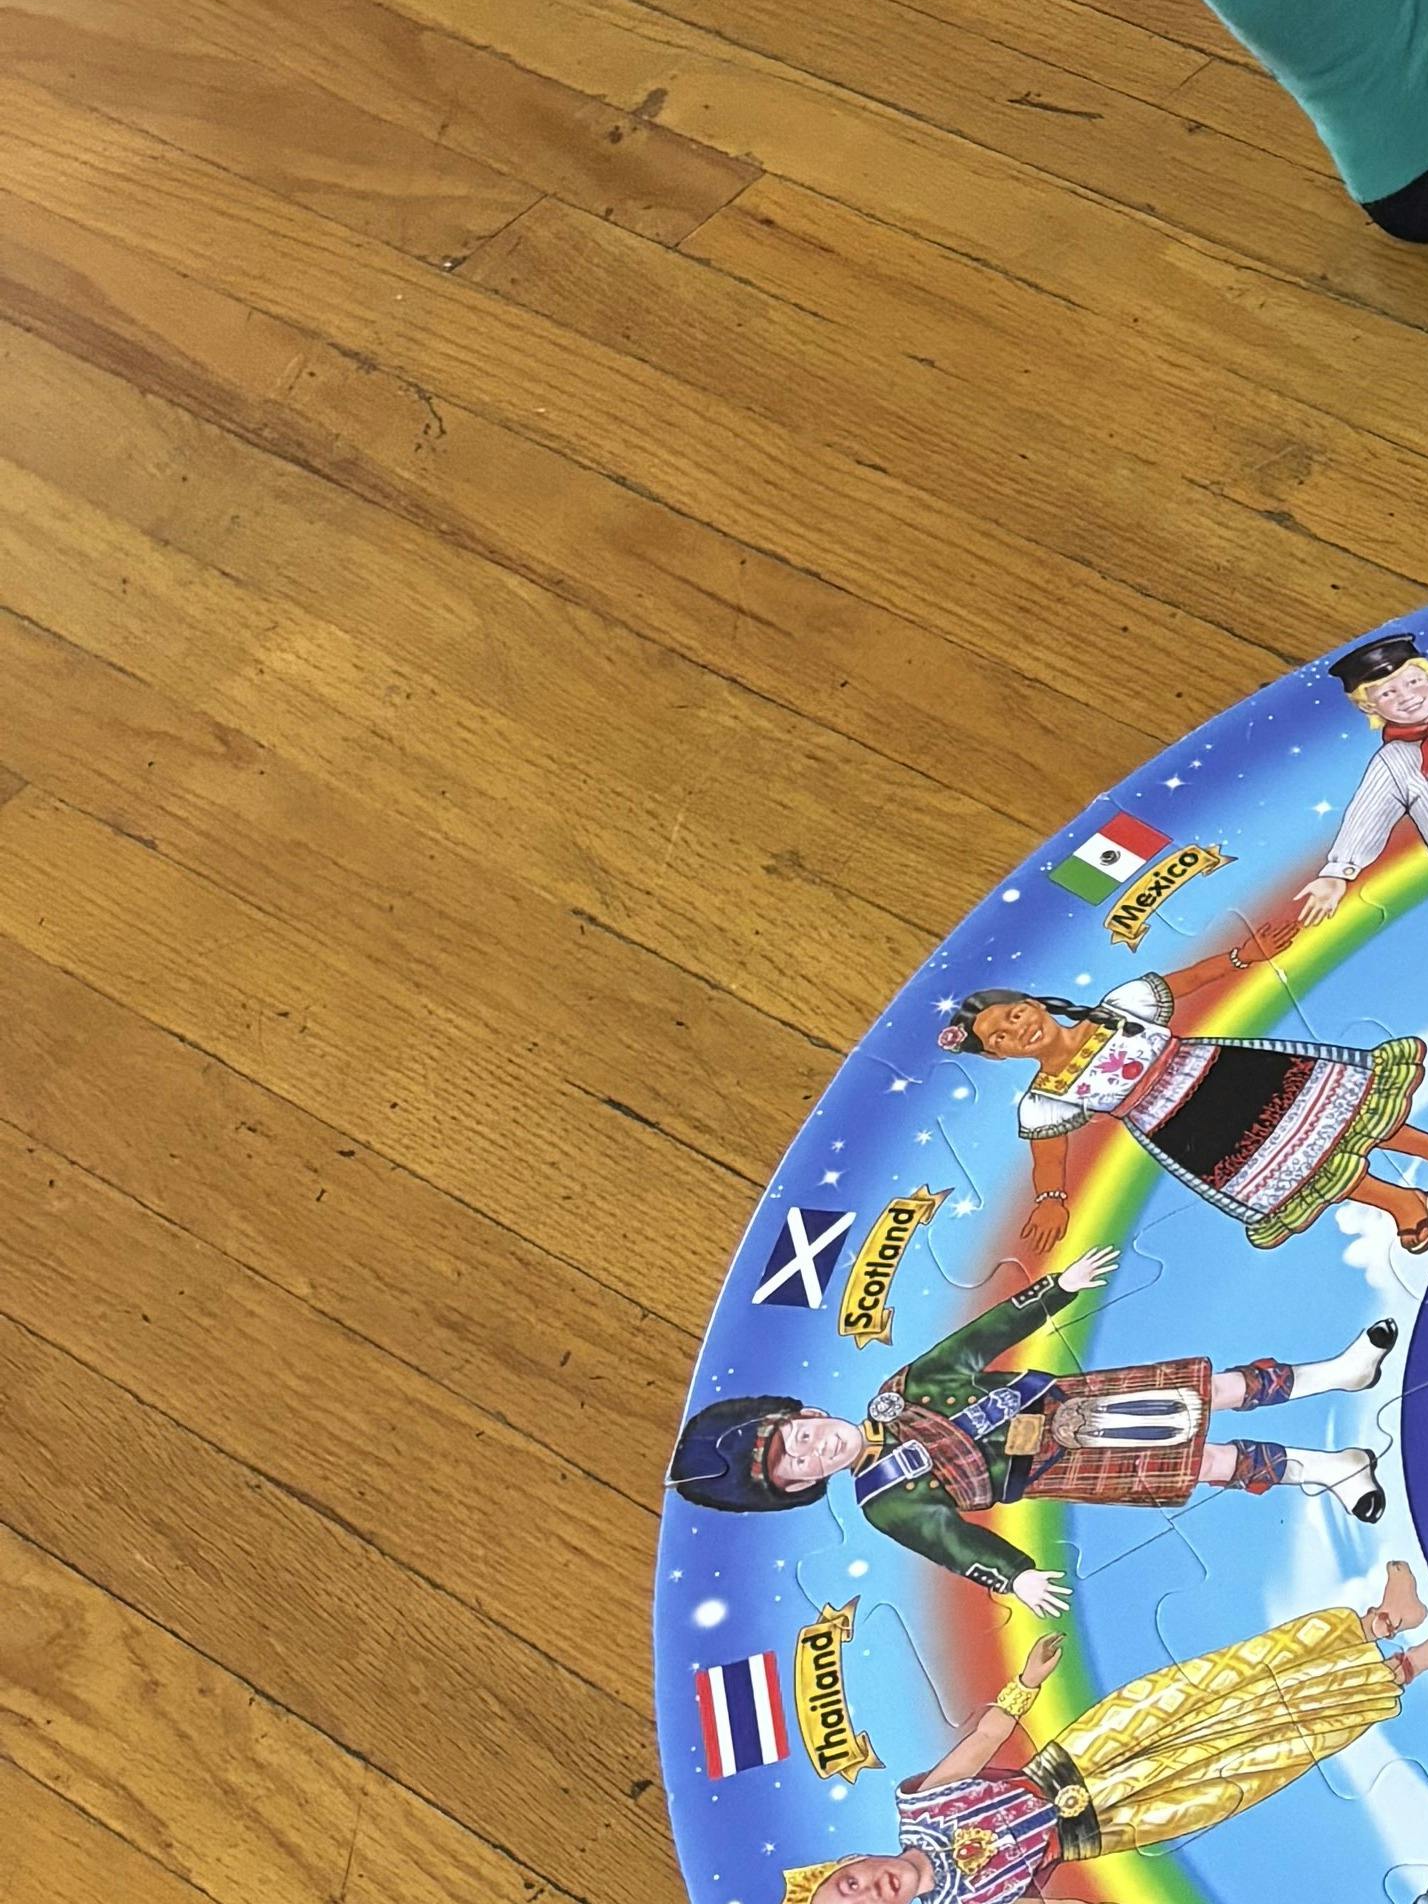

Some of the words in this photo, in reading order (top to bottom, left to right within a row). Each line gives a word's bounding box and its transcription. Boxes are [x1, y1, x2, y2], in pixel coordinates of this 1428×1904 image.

[1111, 852, 1199, 930] Mexico
[844, 1207, 917, 1329] Scotland
[801, 1631, 850, 1770] Thailand
